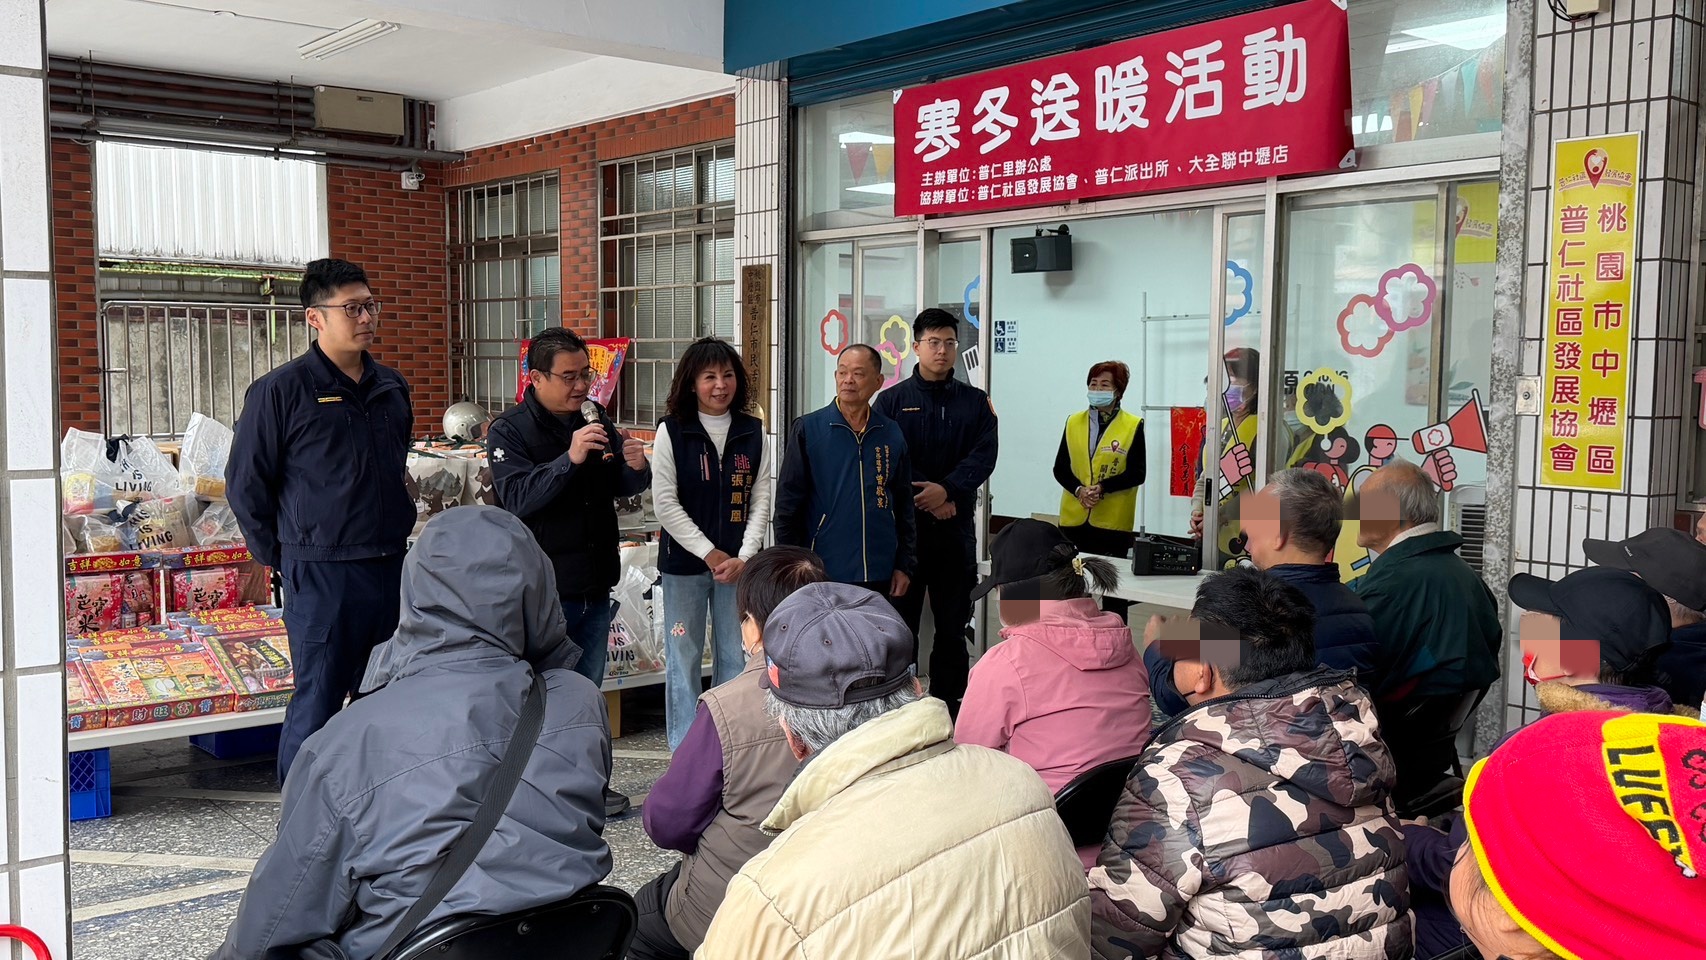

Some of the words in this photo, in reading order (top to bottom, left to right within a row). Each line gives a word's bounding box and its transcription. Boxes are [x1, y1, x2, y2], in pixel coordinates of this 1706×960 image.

[913, 23, 1307, 163] 寒冬送暖活動
[1549, 204, 1589, 473] 普仁社區發展協會
[1586, 203, 1627, 474] 桃園市中壢區
[67, 558, 91, 571] 吉祥
[119, 554, 143, 568] 如意
[183, 552, 205, 566] 吉祥
